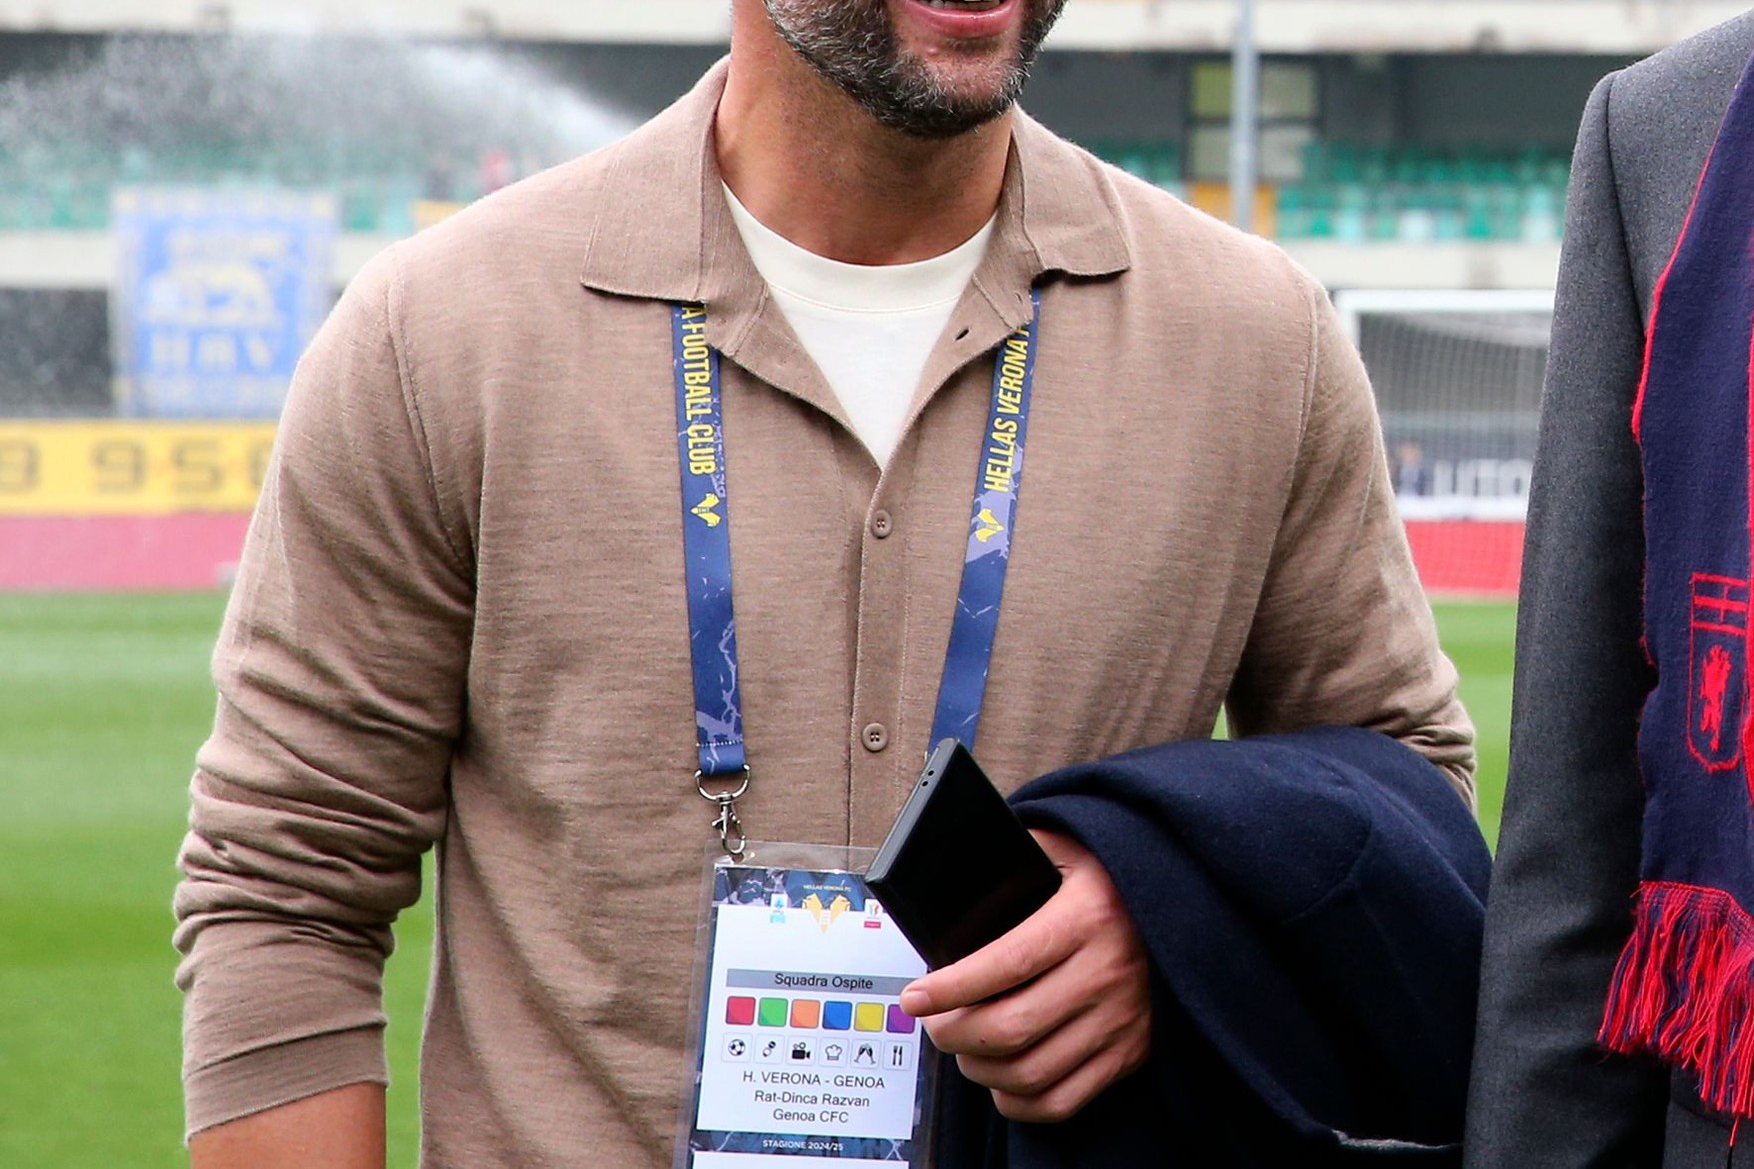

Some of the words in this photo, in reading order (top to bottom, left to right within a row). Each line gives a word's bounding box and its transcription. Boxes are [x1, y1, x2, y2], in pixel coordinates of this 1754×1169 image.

[682, 323, 712, 421] FOOTBALL
[996, 338, 1029, 415] VERONA
[686, 423, 716, 476] CLUB
[984, 417, 1018, 493] HELLAS
[774, 972, 828, 989] Squadra
[831, 975, 874, 992] Ospite
[742, 1070, 757, 1083] H.
[761, 1071, 822, 1086] VERONA
[833, 1074, 886, 1089] GENOA
[754, 1090, 818, 1105] Rat-Dinca
[821, 1093, 870, 1107] Razvan
[772, 1108, 816, 1122] Genoa
[819, 1110, 850, 1124] CFC
[762, 1139, 807, 1150] STAGIONE
[807, 1141, 844, 1151] 2024/25
